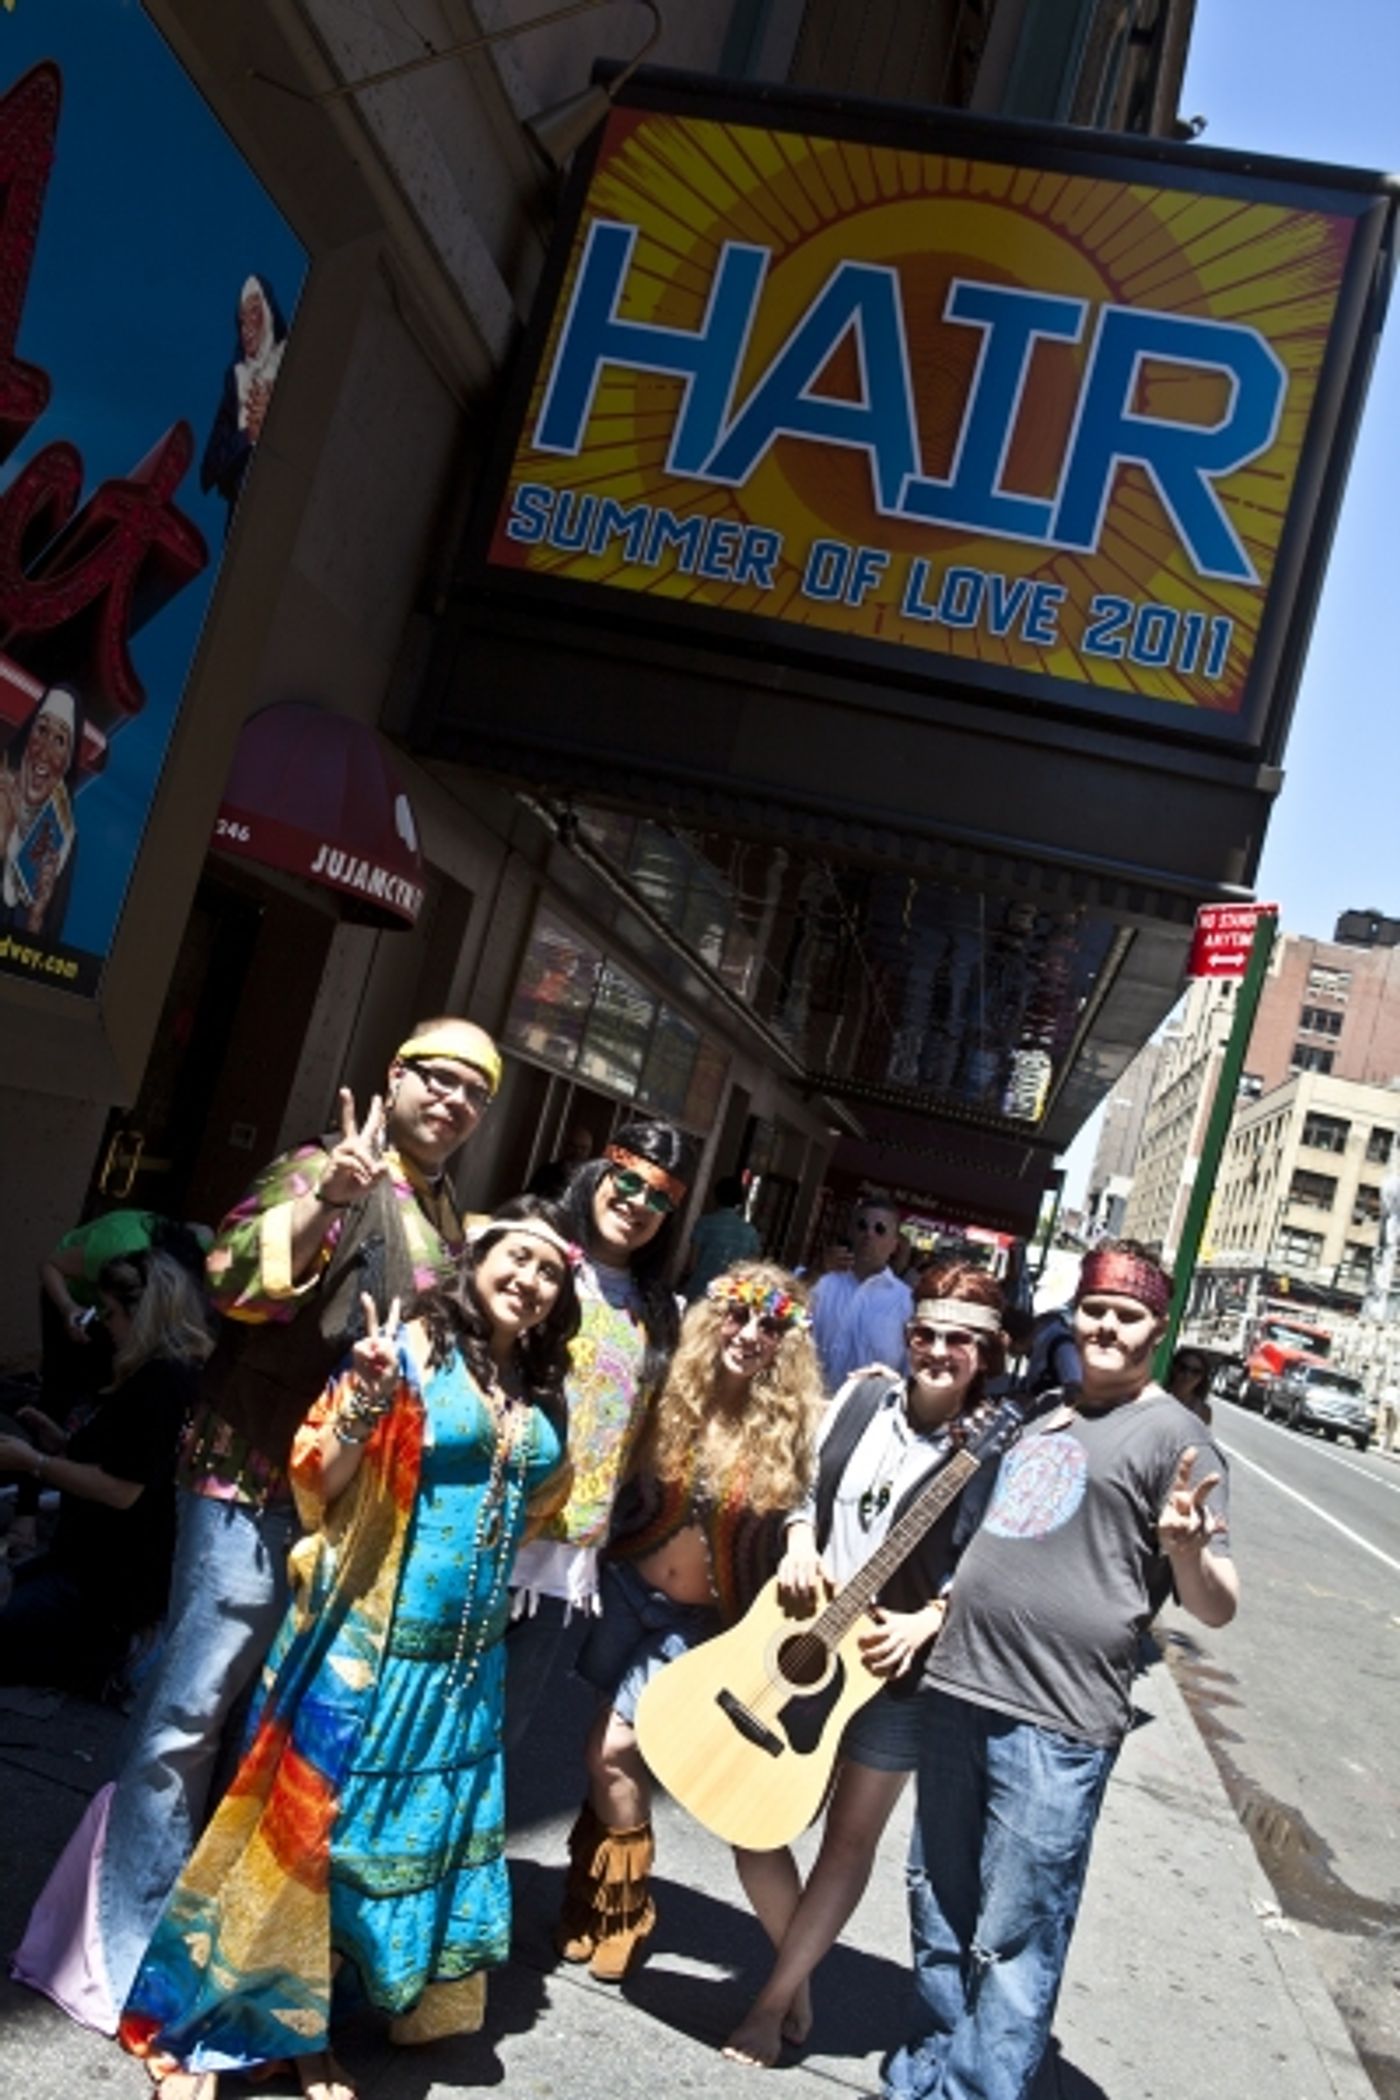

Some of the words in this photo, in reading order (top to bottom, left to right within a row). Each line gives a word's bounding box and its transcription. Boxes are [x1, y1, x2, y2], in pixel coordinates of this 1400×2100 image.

[530, 219, 1288, 588] HAIR
[506, 481, 784, 590] SUMMER
[802, 537, 890, 608] OF
[903, 555, 1067, 649] LOVE
[1081, 593, 1235, 680] 2011
[215, 817, 251, 843] 246
